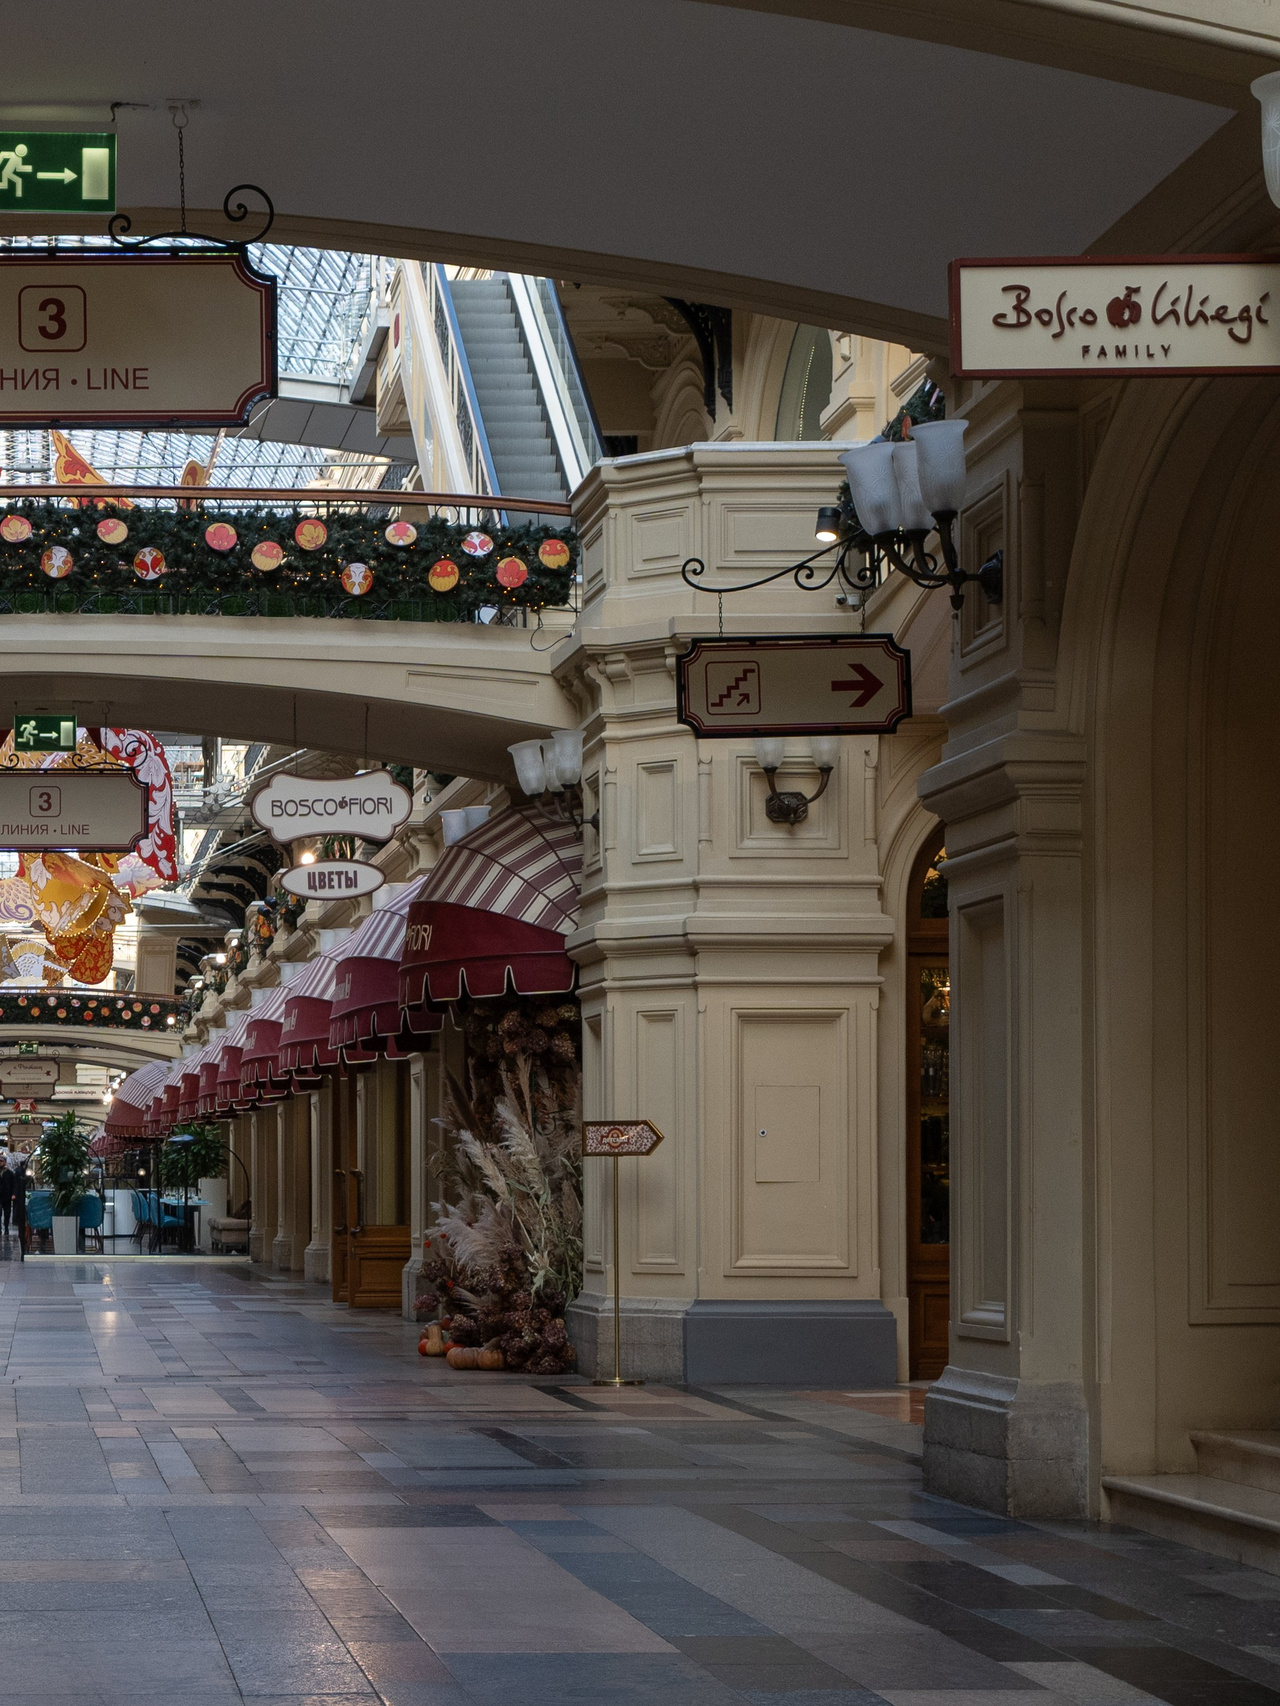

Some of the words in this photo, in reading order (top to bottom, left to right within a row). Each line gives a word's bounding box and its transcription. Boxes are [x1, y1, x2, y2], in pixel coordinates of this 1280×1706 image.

[37, 297, 68, 341] 3
[992, 284, 1098, 339] Bosco
[1151, 281, 1270, 343] Ciliegi
[1081, 344, 1172, 359] FAMILY
[86, 367, 150, 391] LINE
[38, 791, 52, 812] 3
[271, 798, 338, 817] BOSCO
[349, 797, 393, 815] FIORI
[0, 824, 49, 835] ЛИНИЯ
[60, 824, 90, 835] LINE
[307, 870, 358, 892] ЦВЕТЫ
